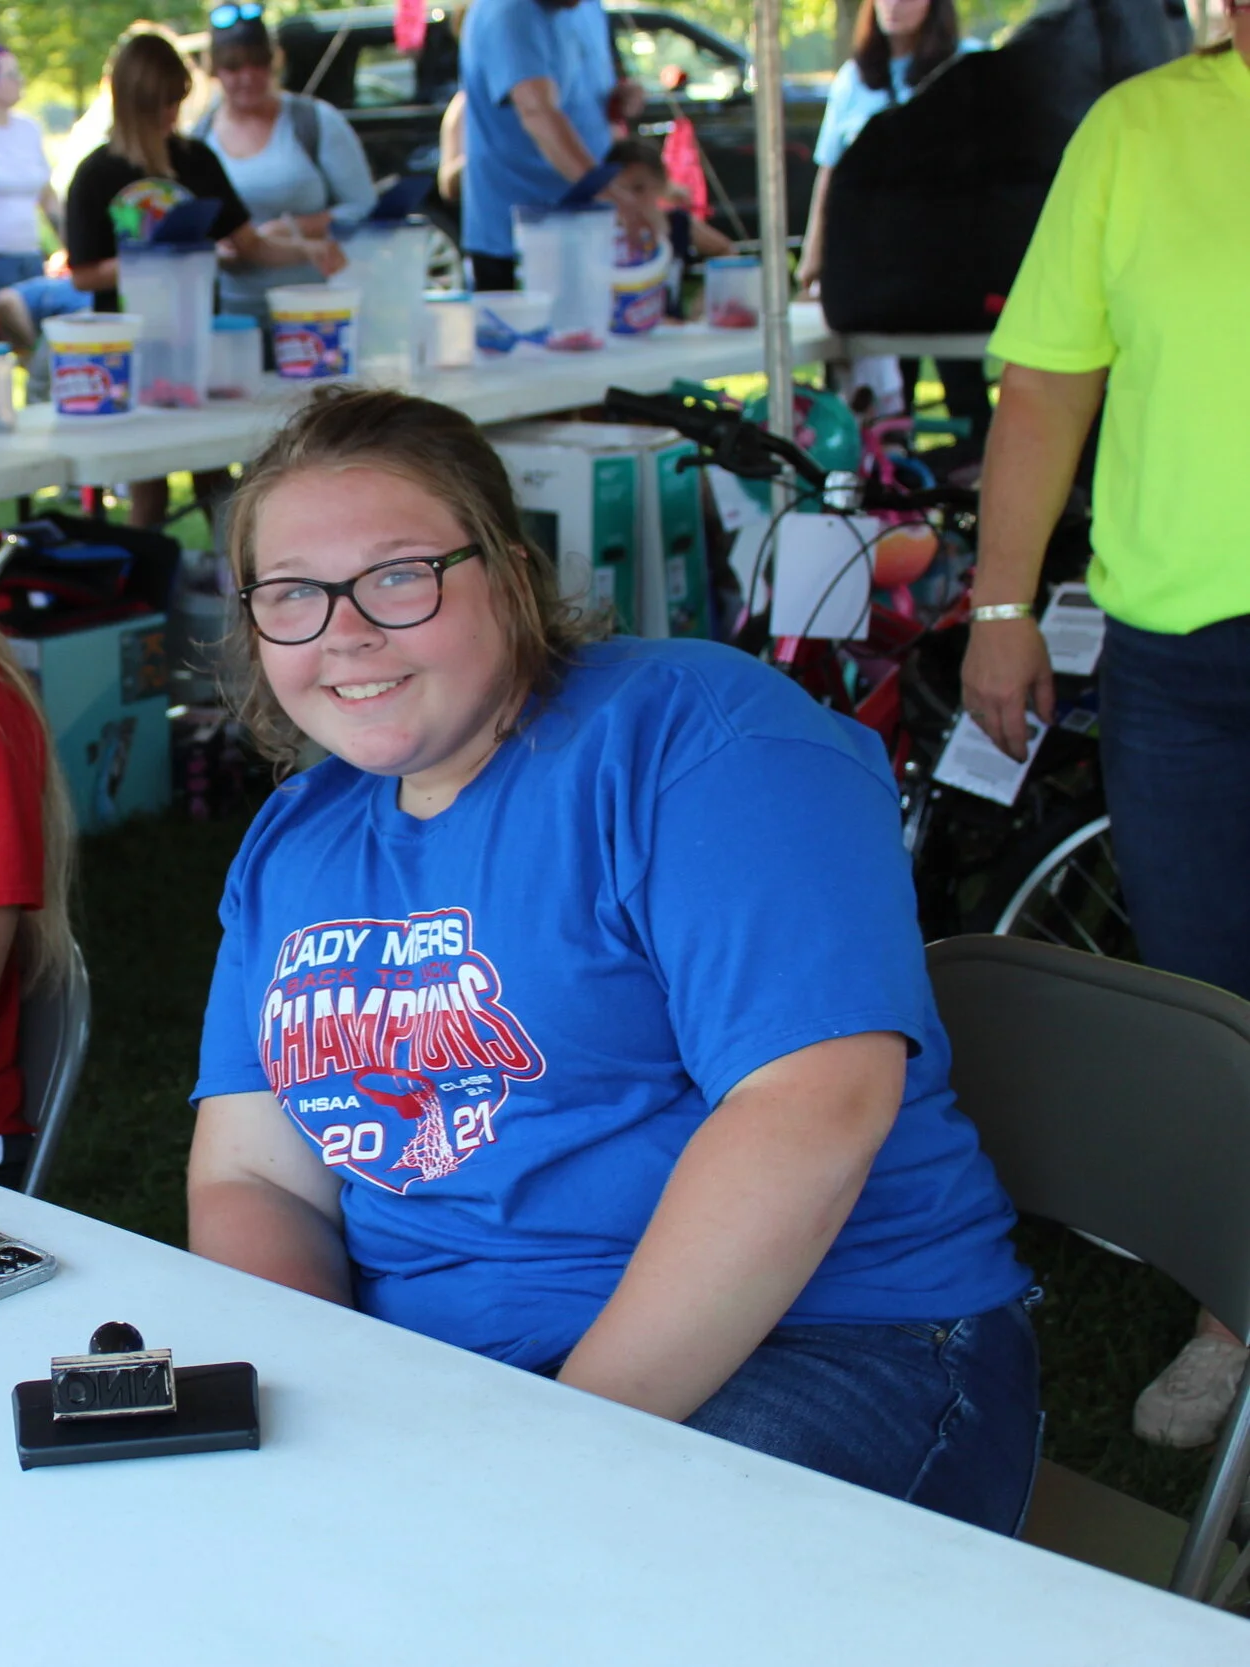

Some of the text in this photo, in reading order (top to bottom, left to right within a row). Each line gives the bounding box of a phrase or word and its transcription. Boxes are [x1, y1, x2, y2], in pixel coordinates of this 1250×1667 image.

[278, 928, 372, 980] LADY
[285, 967, 358, 996] BACK
[376, 969, 414, 987] TO
[263, 963, 533, 1097] CHAMPIONS
[438, 1073, 494, 1092] CLASS
[464, 1085, 492, 1097] 2A
[298, 1095, 361, 1113] IHSAA
[321, 1121, 385, 1167] 20
[452, 1100, 497, 1151] 21
